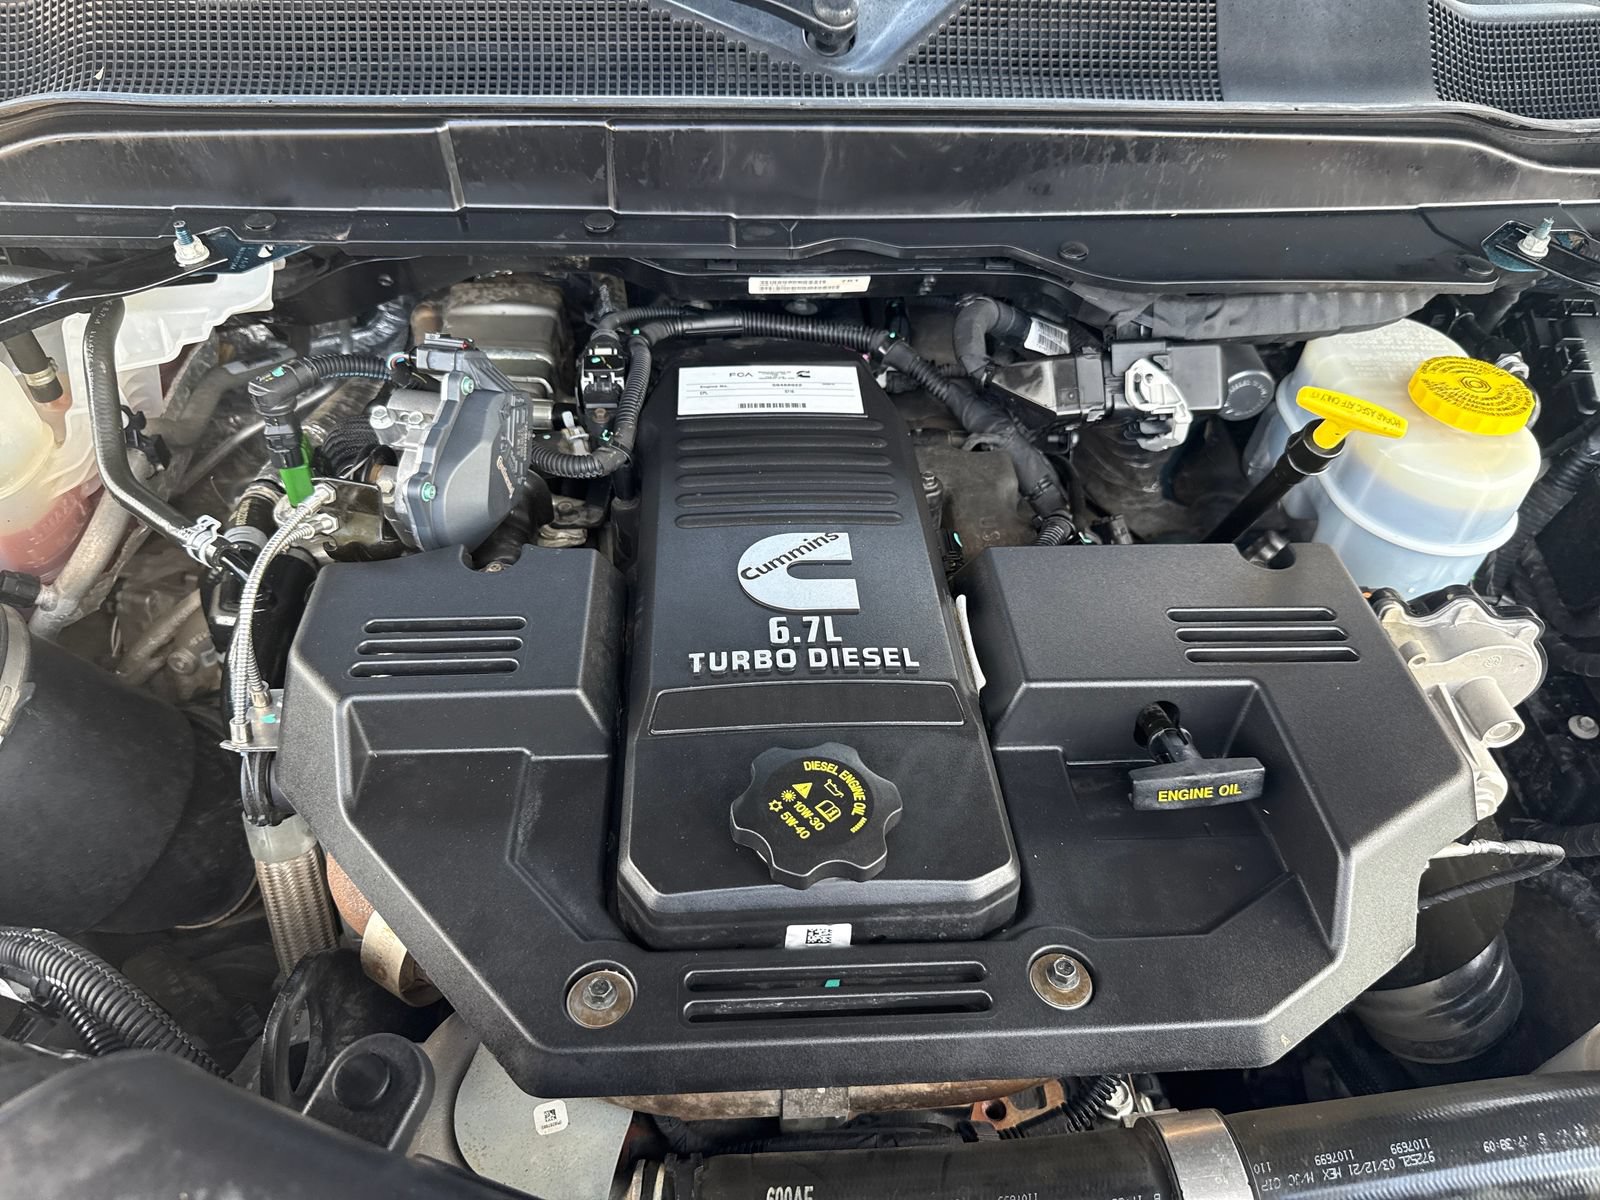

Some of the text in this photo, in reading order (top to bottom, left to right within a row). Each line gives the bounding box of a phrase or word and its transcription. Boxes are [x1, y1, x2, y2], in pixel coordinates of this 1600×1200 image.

[740, 532, 840, 581] Cummins
[768, 615, 843, 646] 6.7L
[688, 647, 921, 675] TURBO DIESEL
[803, 761, 838, 776] DIESEL
[838, 770, 867, 802] ENGINE
[1158, 783, 1242, 802] ENGINE OIL
[793, 800, 826, 832] 10W-30
[851, 802, 867, 816] OIL
[780, 811, 811, 840] 5W-40
[1390, 1138, 1431, 1155] 1107699
[1314, 1149, 1355, 1166] 1107699
[1348, 1158, 1396, 1176] 03/12/21
[1322, 1166, 1342, 1181] MEX
